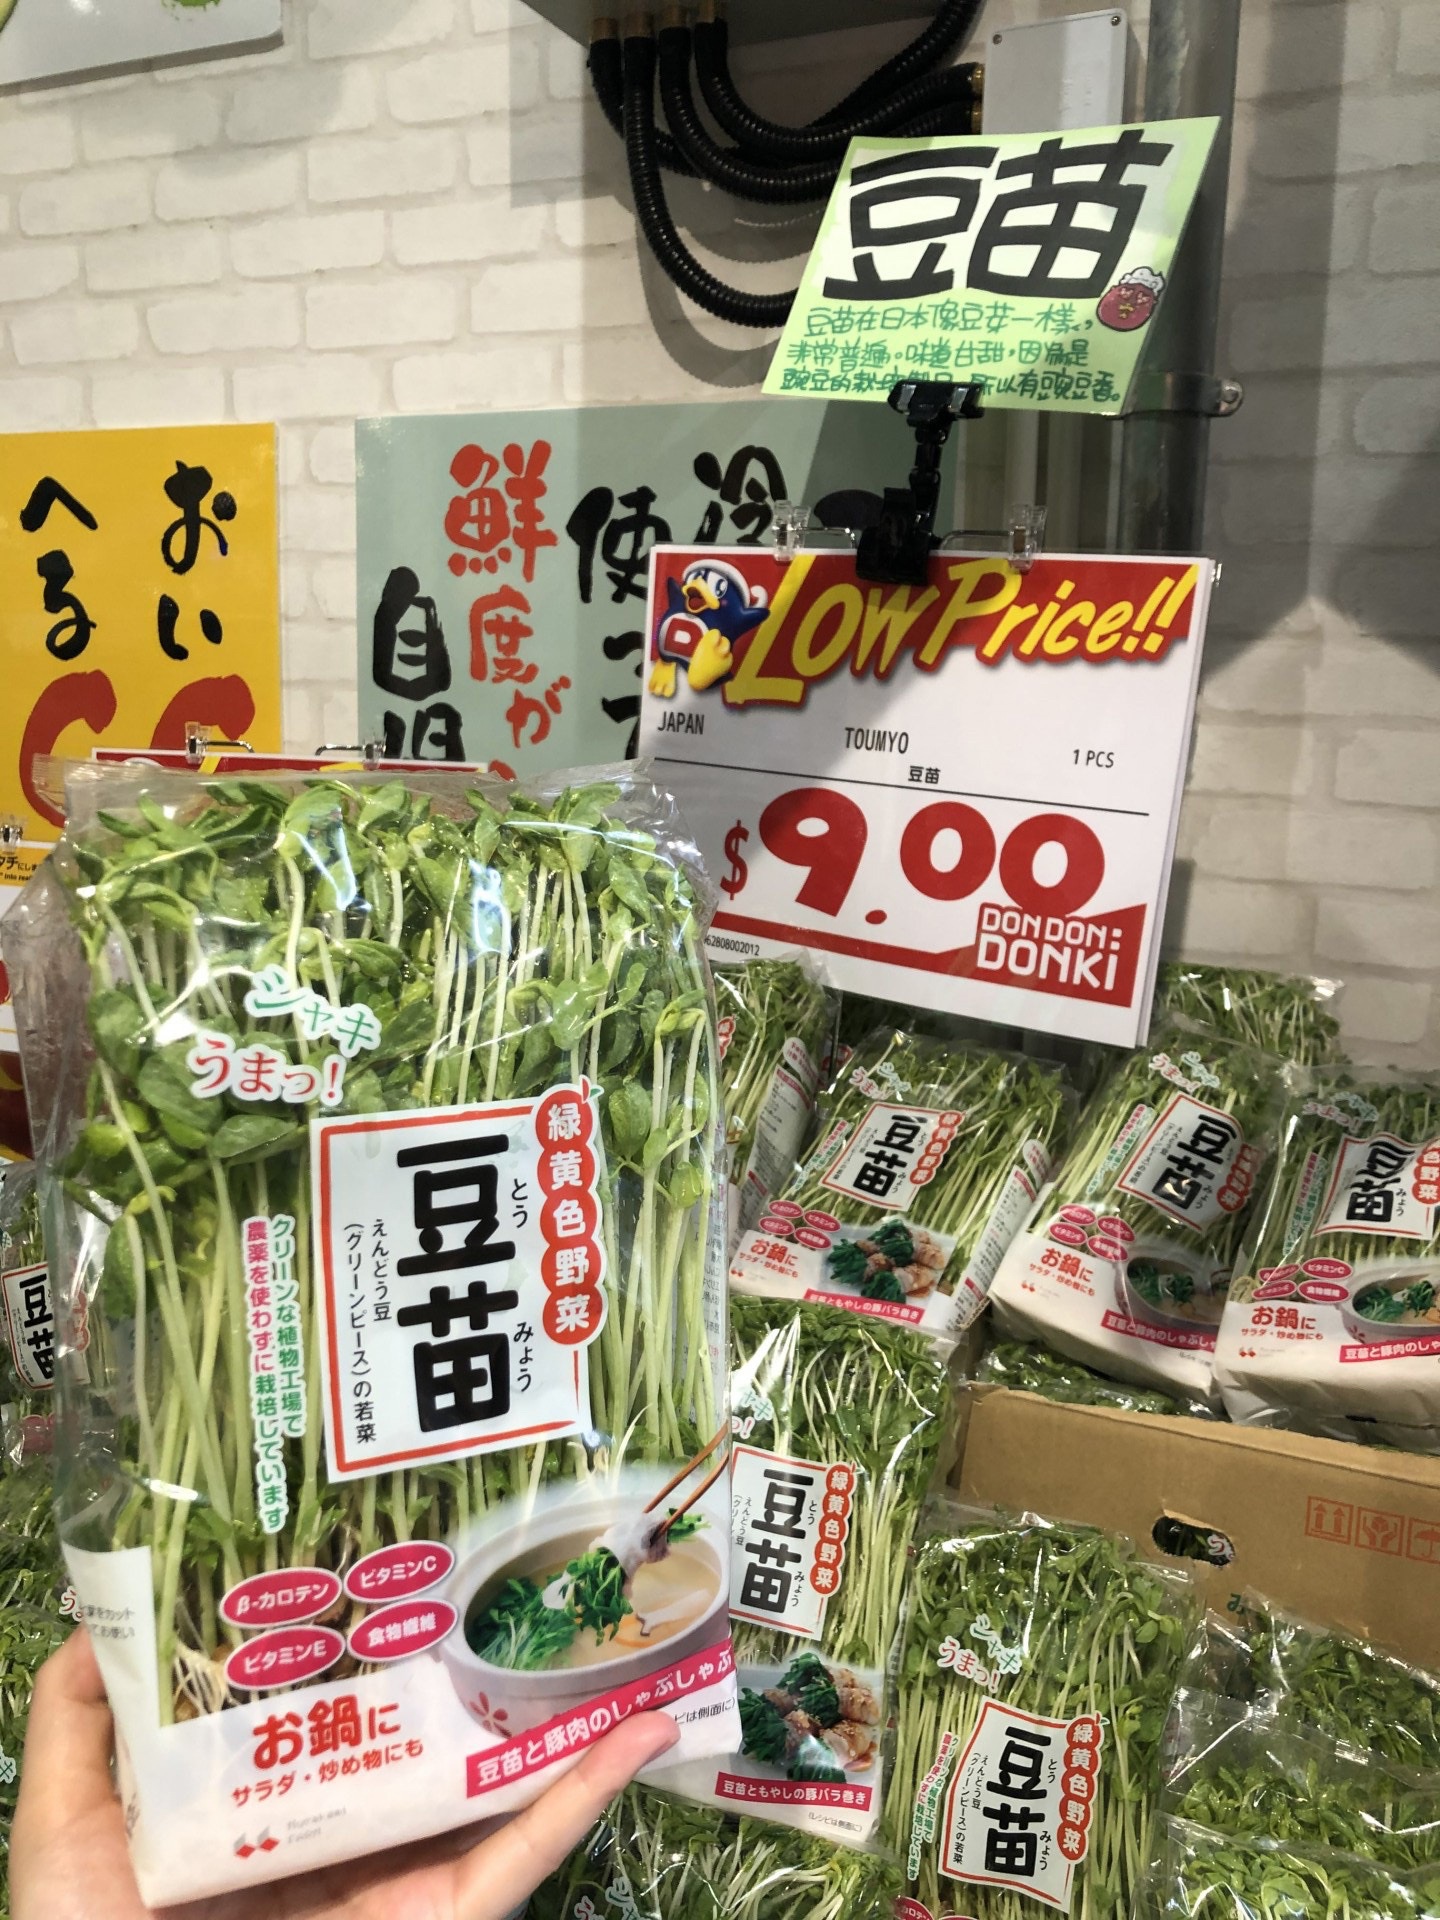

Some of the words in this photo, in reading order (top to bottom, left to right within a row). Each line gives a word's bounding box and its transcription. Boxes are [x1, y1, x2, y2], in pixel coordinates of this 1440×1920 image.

[822, 128, 1174, 300] 豆苗
[444, 439, 572, 781] 鮮度が
[657, 711, 705, 736] JAPAN
[844, 727, 910, 756] TOUMYO
[1073, 748, 1081, 767] 1
[1086, 750, 1115, 769] PCS
[907, 764, 942, 786] 豆苗
[981, 906, 1043, 939] DON
[253, 971, 375, 1050] シャキ
[852, 1114, 929, 1198] 豆苗
[1151, 1113, 1238, 1210] 豆苗
[1345, 1140, 1416, 1223] 豆苗
[511, 1178, 529, 1228] とう
[546, 1101, 592, 1335] 緑黄色野菜
[371, 1218, 393, 1322] えんどう豆
[396, 1133, 520, 1434] 豆苗
[750, 1238, 799, 1267] お鍋に
[1040, 1247, 1095, 1283] お鍋に
[272, 1216, 305, 1437] クリーンな植物工場で
[1250, 1305, 1317, 1331] お鍋に
[246, 1220, 285, 1530] 農薬を使わずに栽培しています
[512, 1321, 534, 1393] みょう
[739, 1467, 815, 1614] 豆苗
[807, 1500, 818, 1526] とう
[815, 1469, 850, 1588] 緑黄色野菜
[359, 1555, 438, 1590] ビタミンC
[243, 1638, 328, 1674] ビタミンE
[368, 1612, 438, 1648] 食物繊維
[252, 1693, 402, 1770] お鍋に
[231, 1738, 425, 1808] サラダ・炒め物にも
[723, 1779, 867, 1806] 豆苗ともやしの豚バラ巻き
[971, 1755, 989, 1810] えんどう豆
[982, 1725, 1053, 1878] 豆苗
[1047, 1758, 1057, 1785] とう
[1063, 1723, 1095, 1854] 緑黄色野菜
[1038, 1830, 1053, 1871] みょう
